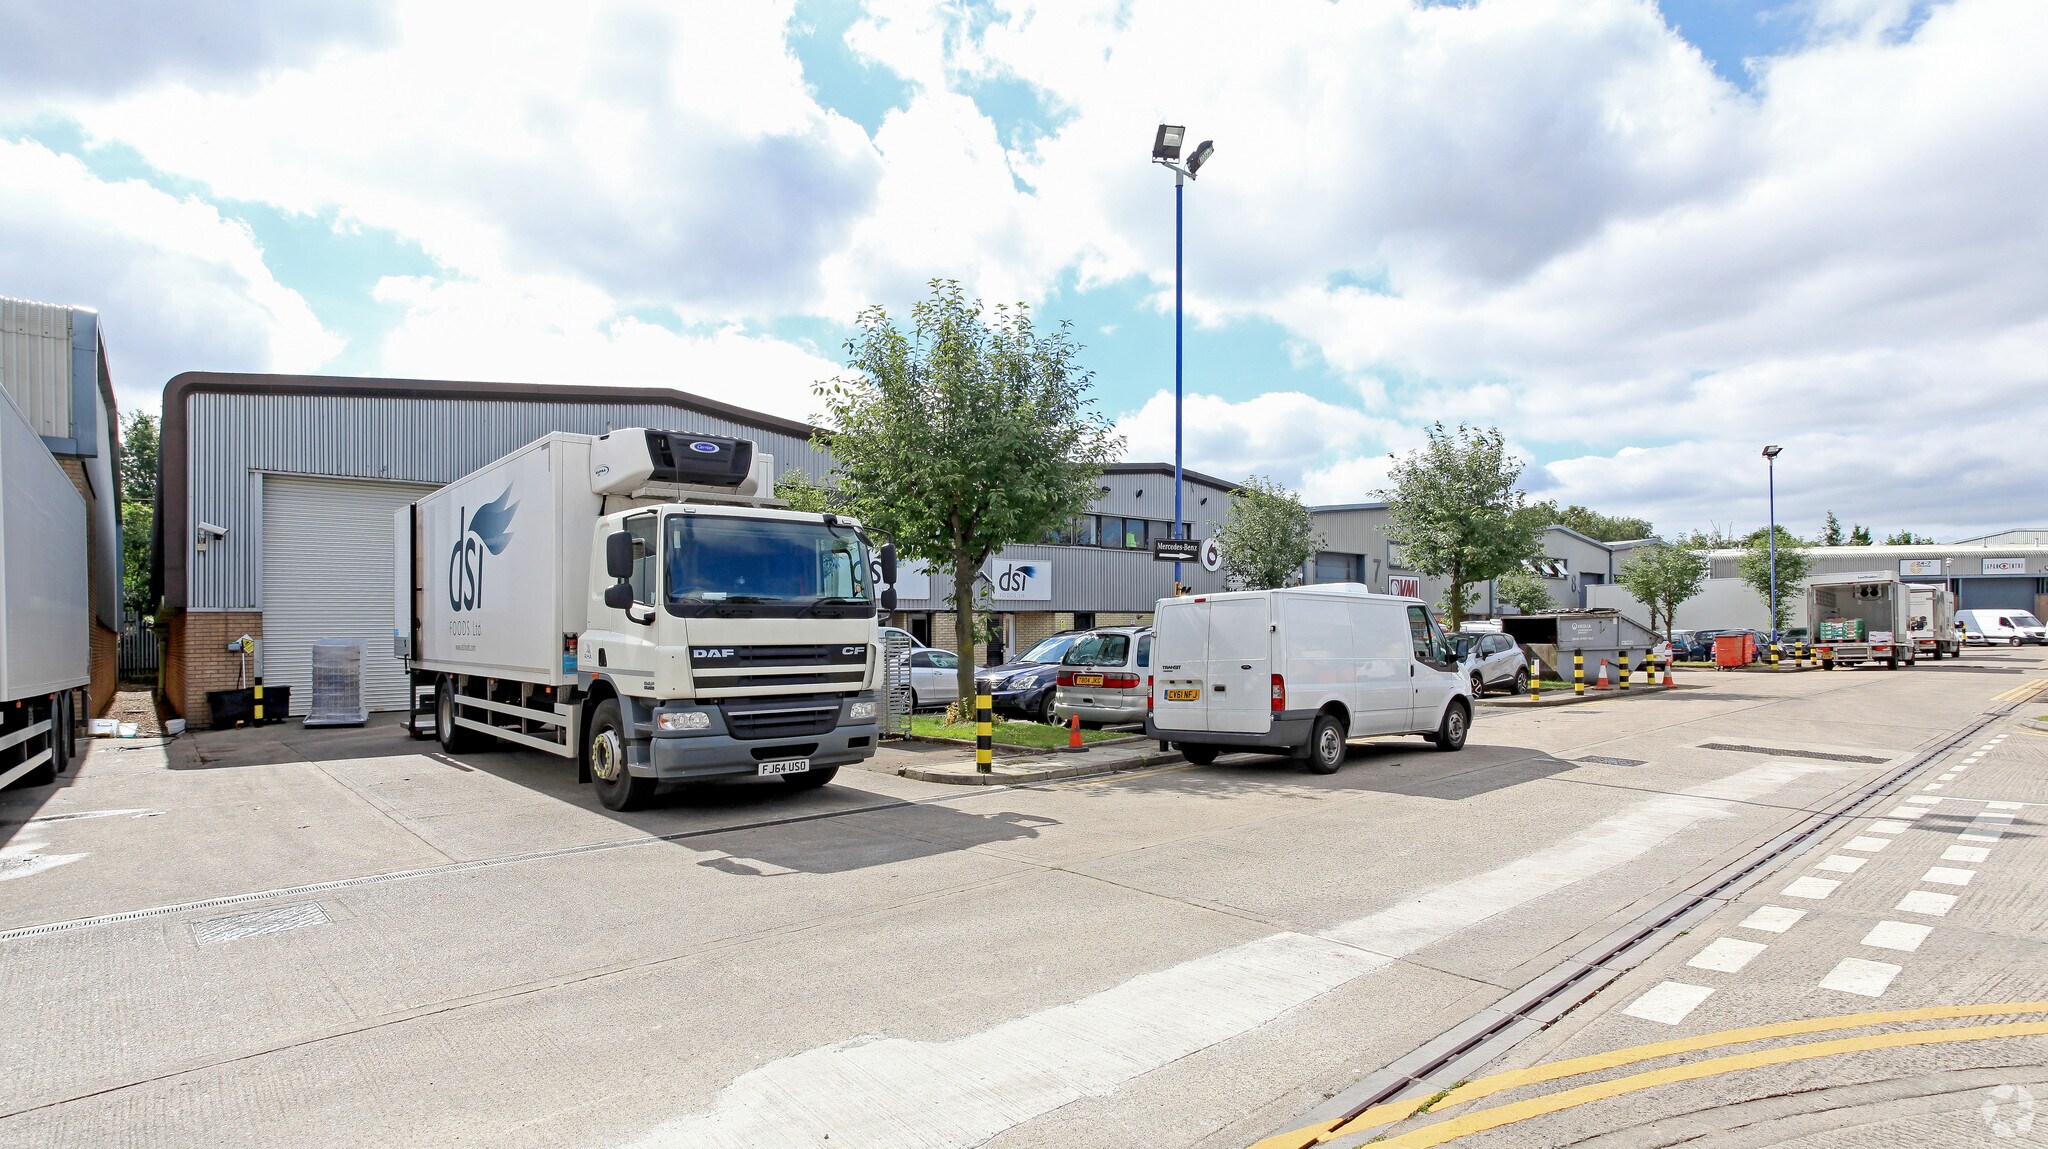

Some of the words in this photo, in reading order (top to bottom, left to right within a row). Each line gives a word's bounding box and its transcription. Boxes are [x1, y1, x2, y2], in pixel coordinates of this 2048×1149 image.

[1157, 543, 1198, 552] Mercedes-Benz
[1206, 543, 1218, 566] 6
[999, 563, 1026, 591] dsi
[1373, 559, 1381, 583] 7
[1571, 575, 1577, 593] 8
[450, 620, 470, 636] FOODS
[693, 649, 734, 658] DAF
[841, 646, 865, 656] CF
[1168, 690, 1183, 699] CV61
[1183, 690, 1198, 699] NFJ
[762, 763, 786, 774] FJ64
[788, 761, 806, 772] USO
